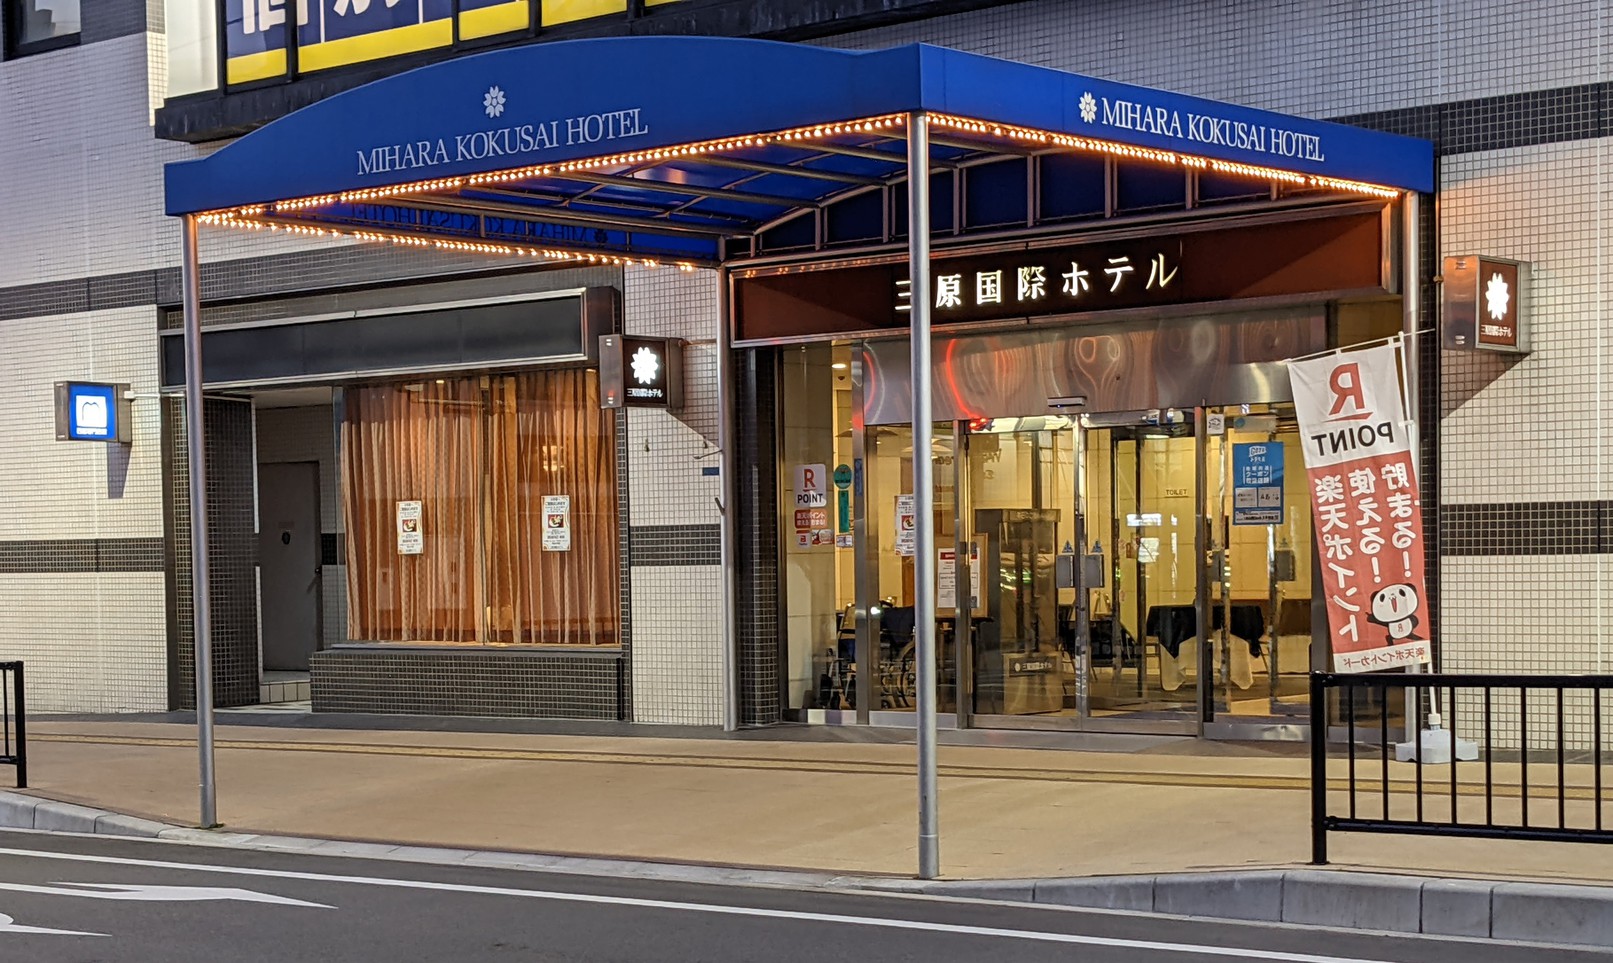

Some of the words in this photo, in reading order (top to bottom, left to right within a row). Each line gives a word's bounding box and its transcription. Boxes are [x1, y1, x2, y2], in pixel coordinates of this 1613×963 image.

[357, 139, 450, 175] MIHARA
[455, 121, 559, 161] KOKUSAI
[566, 108, 648, 146] HOTEL
[1101, 98, 1184, 138] MIHARA
[1187, 113, 1266, 152] KOKUSAI
[1269, 128, 1325, 162] HOTEL
[895, 252, 1178, 310] 三原国際ホテル
[797, 493, 823, 504] POINT
[803, 468, 816, 488] R
